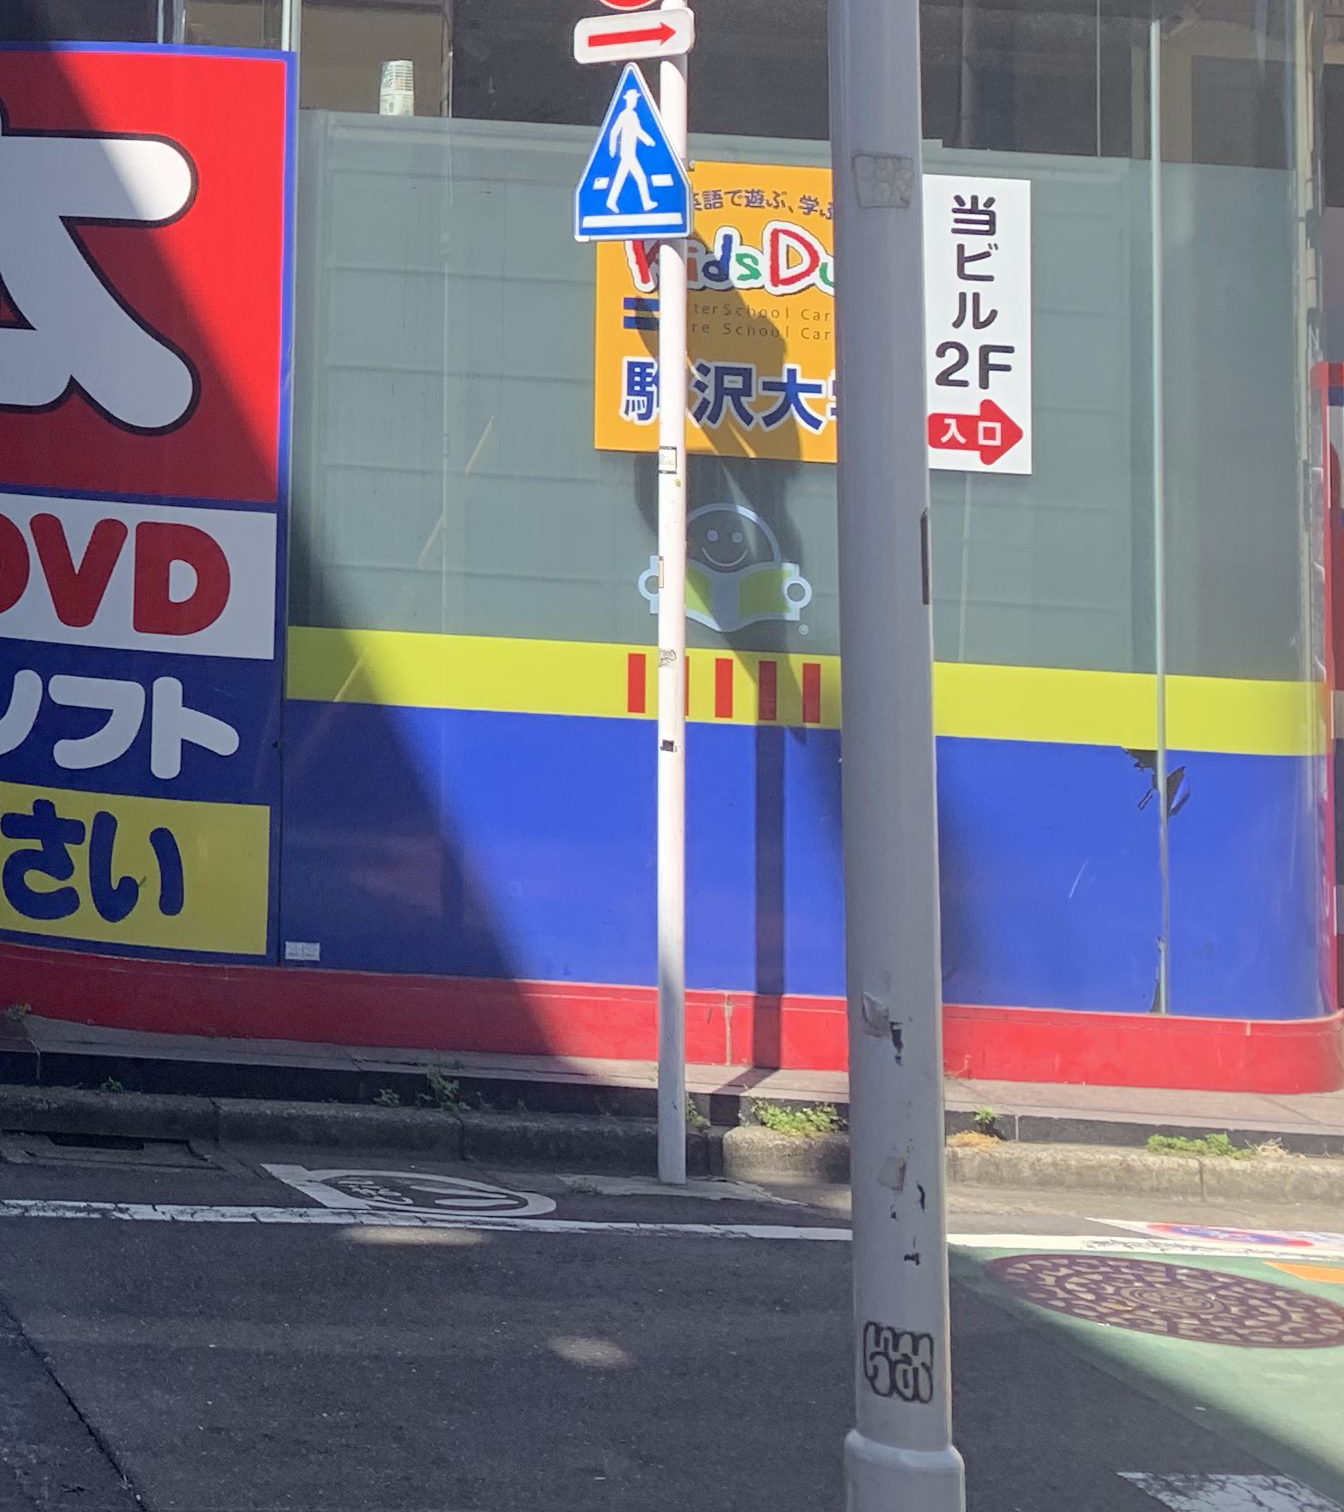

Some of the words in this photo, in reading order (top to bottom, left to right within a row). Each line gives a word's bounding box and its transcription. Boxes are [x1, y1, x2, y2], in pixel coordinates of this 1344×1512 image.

[950, 194, 1000, 330] 当ビル
[723, 322, 790, 339] School
[800, 325, 831, 341] Car
[800, 307, 831, 322] Car
[935, 340, 1015, 390] 2F
[622, 360, 837, 431] 駒沢大
[940, 418, 1002, 447] 入口
